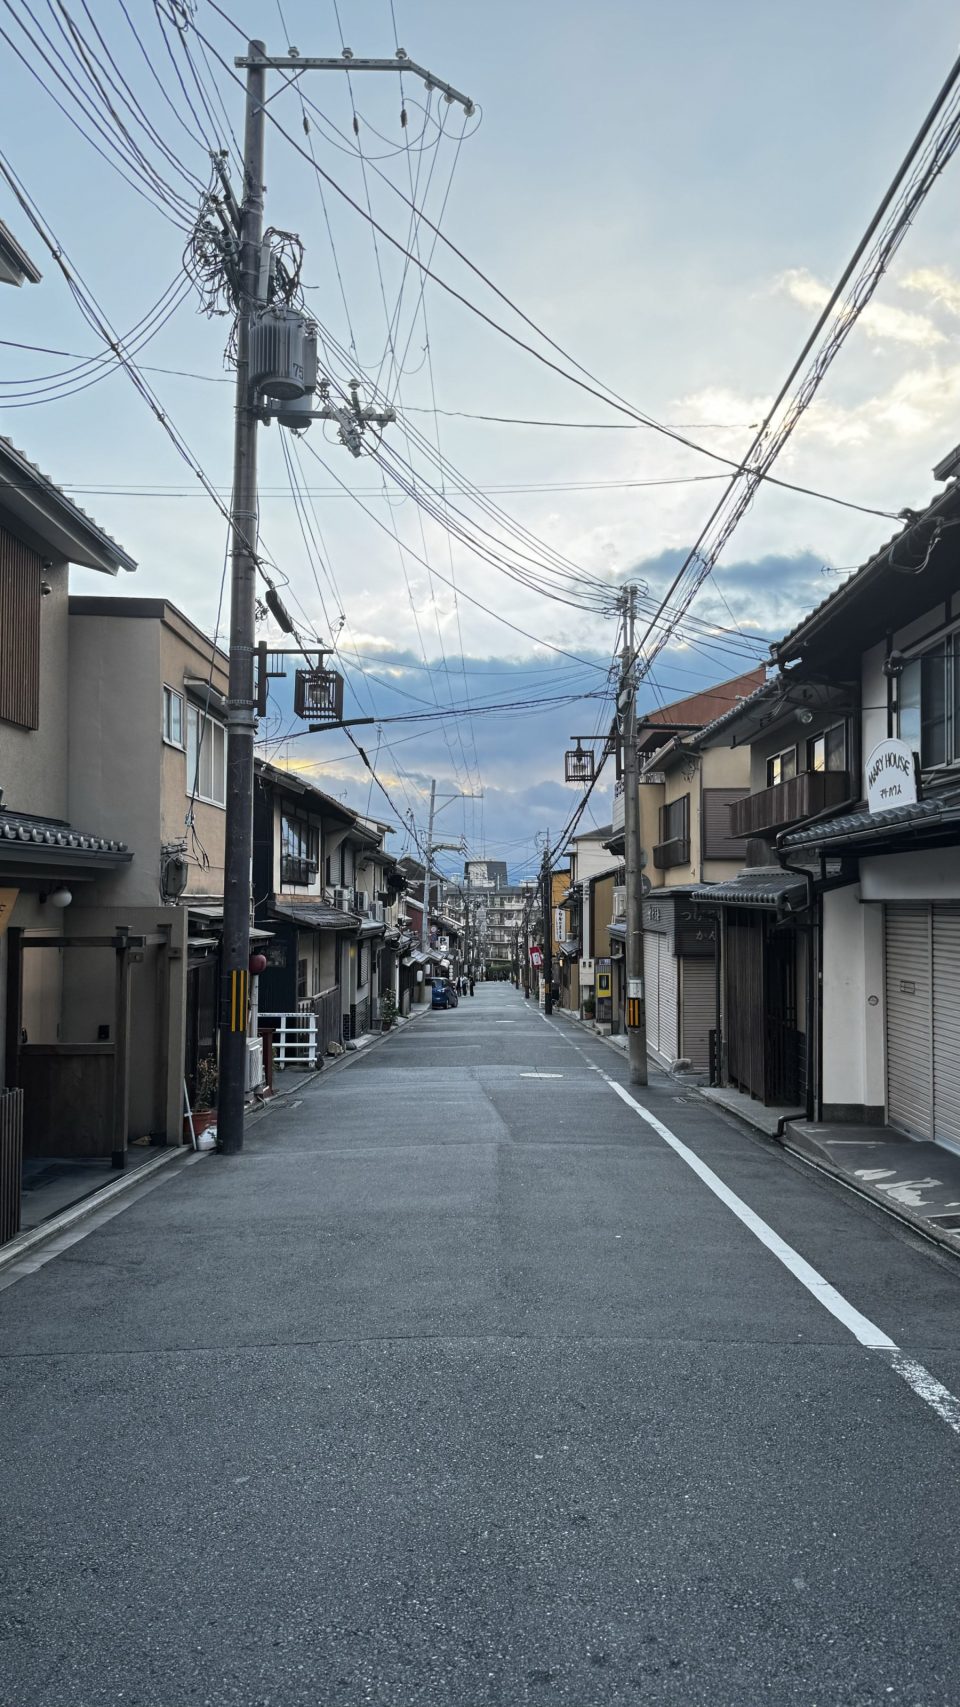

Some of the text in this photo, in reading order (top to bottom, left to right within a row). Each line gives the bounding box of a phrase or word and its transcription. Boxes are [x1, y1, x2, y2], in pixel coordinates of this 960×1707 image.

[293, 363, 304, 381] 75
[869, 752, 910, 790] MARY HOUSE
